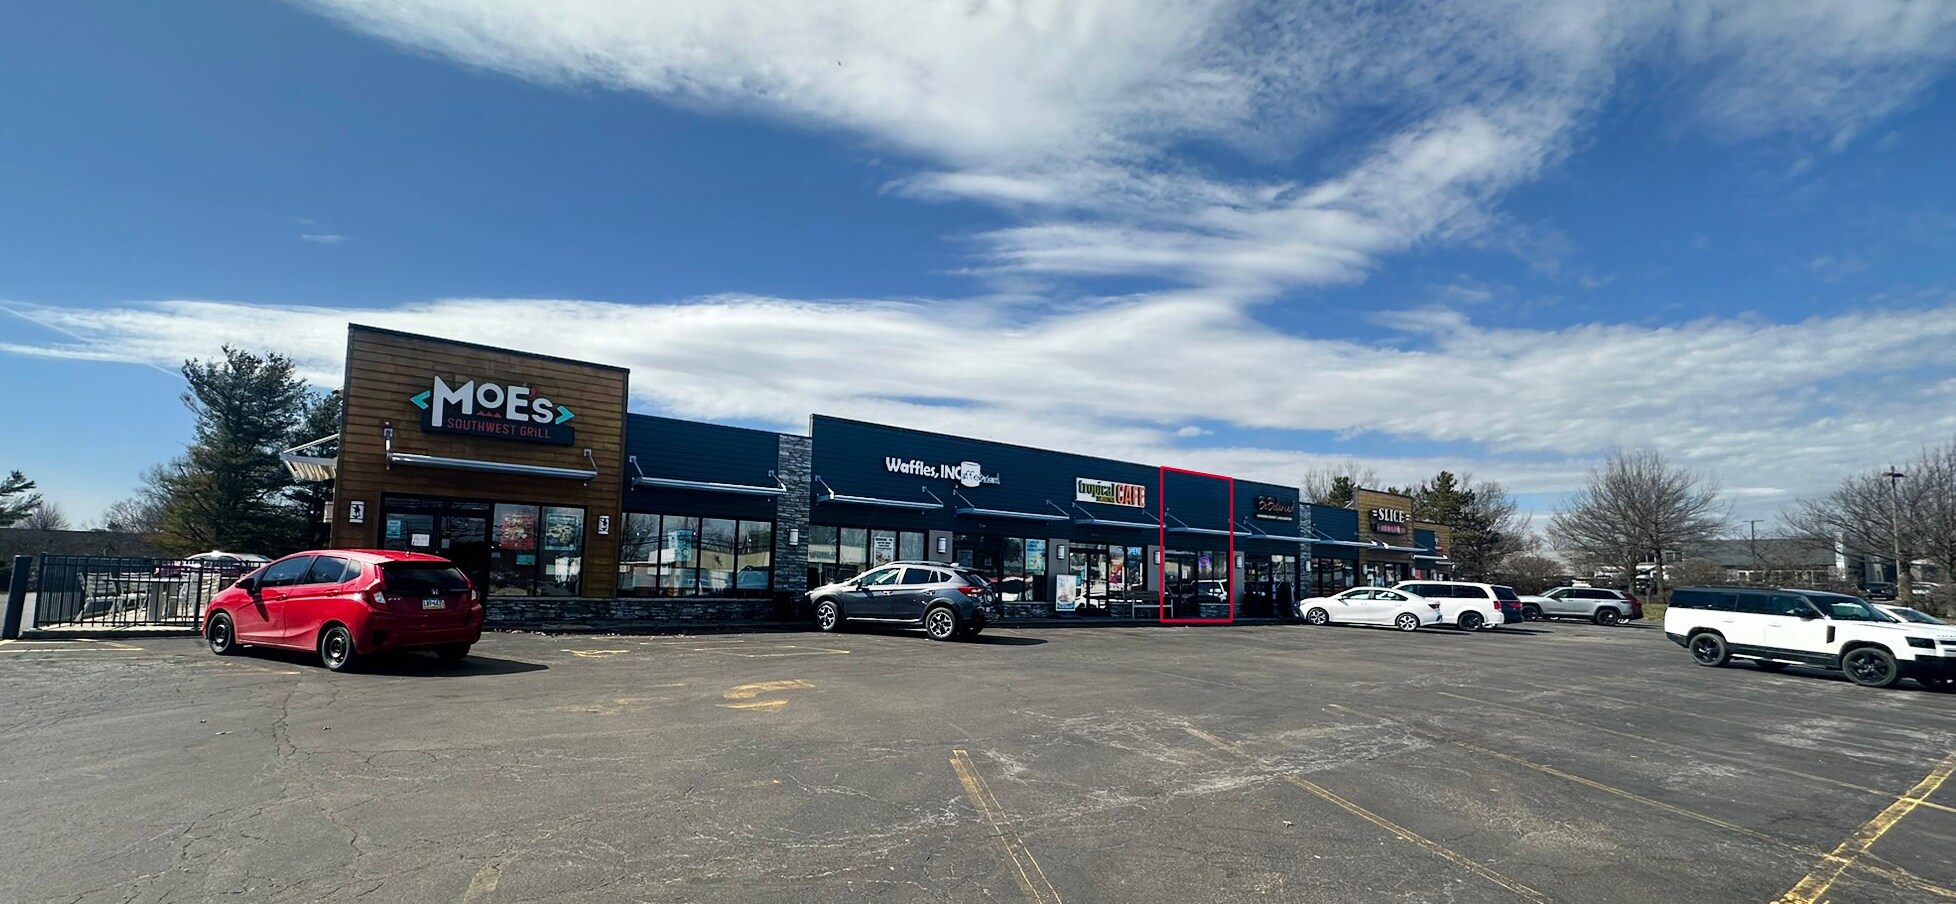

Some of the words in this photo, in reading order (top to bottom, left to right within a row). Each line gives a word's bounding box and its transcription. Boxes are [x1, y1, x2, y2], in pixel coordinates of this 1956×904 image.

[447, 417, 516, 435] SOUTHWEST
[519, 426, 551, 439] GRILL
[885, 456, 939, 478] Waffles,
[1078, 480, 1115, 497] tropical
[1115, 484, 1146, 506] CAFE
[1378, 507, 1405, 523] SLICE
